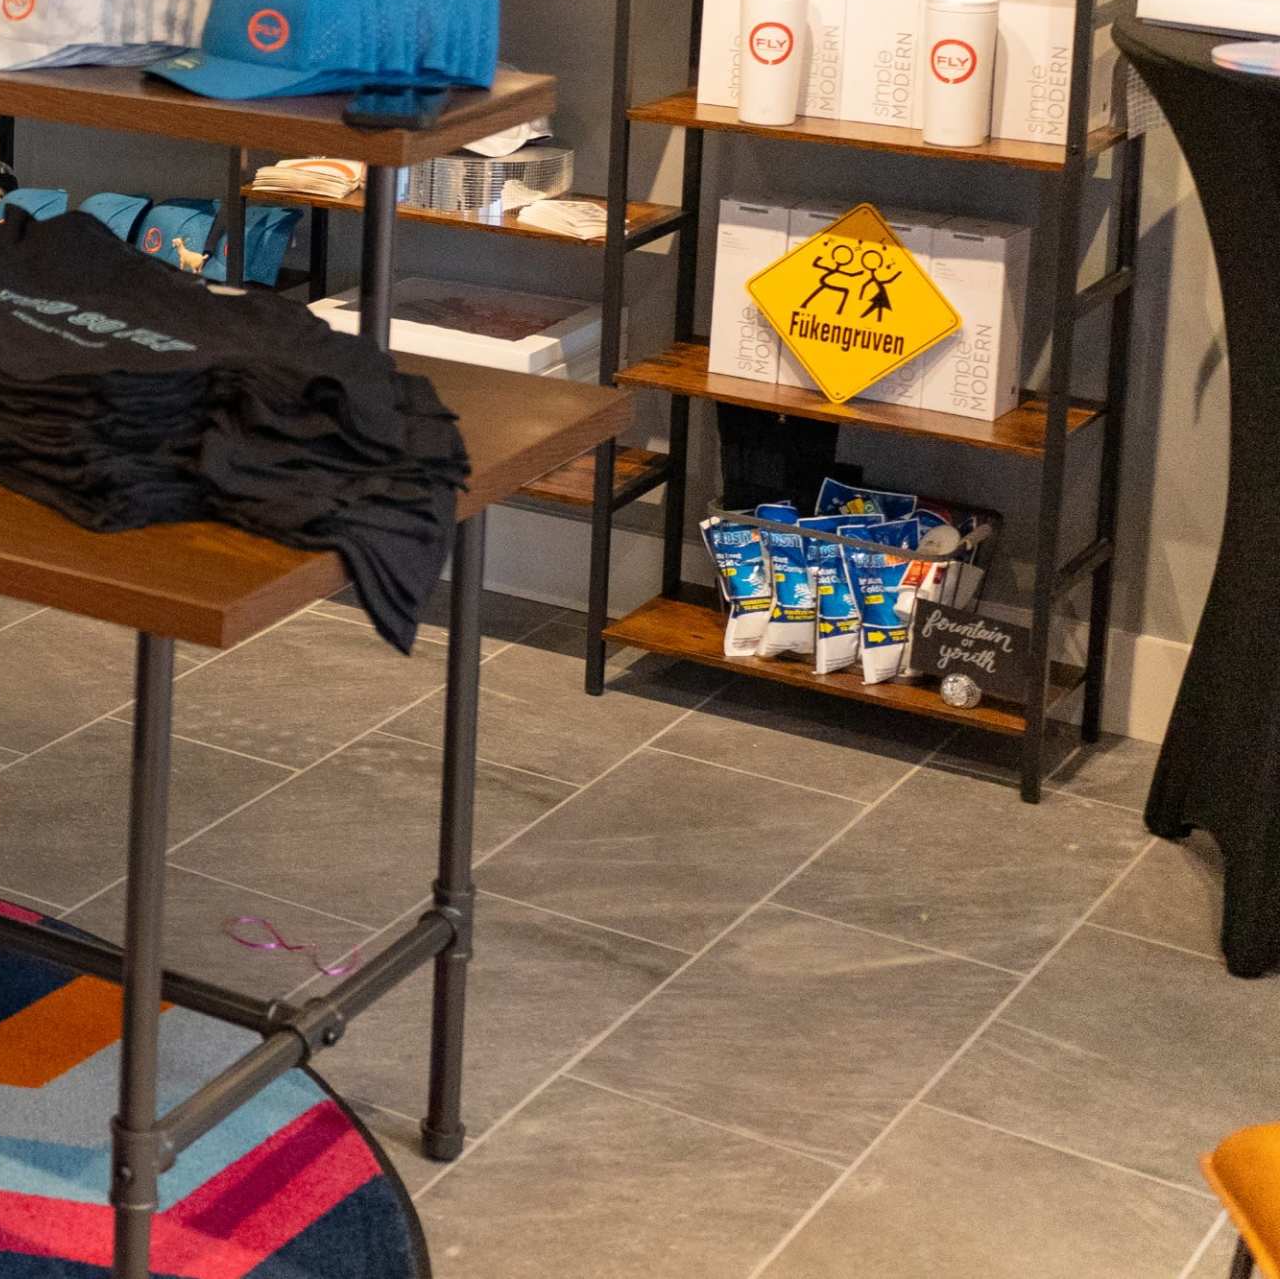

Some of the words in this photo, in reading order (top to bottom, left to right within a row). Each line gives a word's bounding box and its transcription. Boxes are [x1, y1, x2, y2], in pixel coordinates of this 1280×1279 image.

[756, 38, 788, 49] FLY
[819, 25, 839, 112] MODERN
[892, 32, 913, 120] MODERN
[937, 55, 969, 67] FLY
[872, 50, 893, 118] simple
[1026, 64, 1047, 135] simple
[1047, 46, 1068, 136] MODERN
[950, 339, 972, 408] simple
[971, 323, 993, 412] MODERN
[921, 609, 1013, 653] fountain
[936, 644, 996, 673] youth
